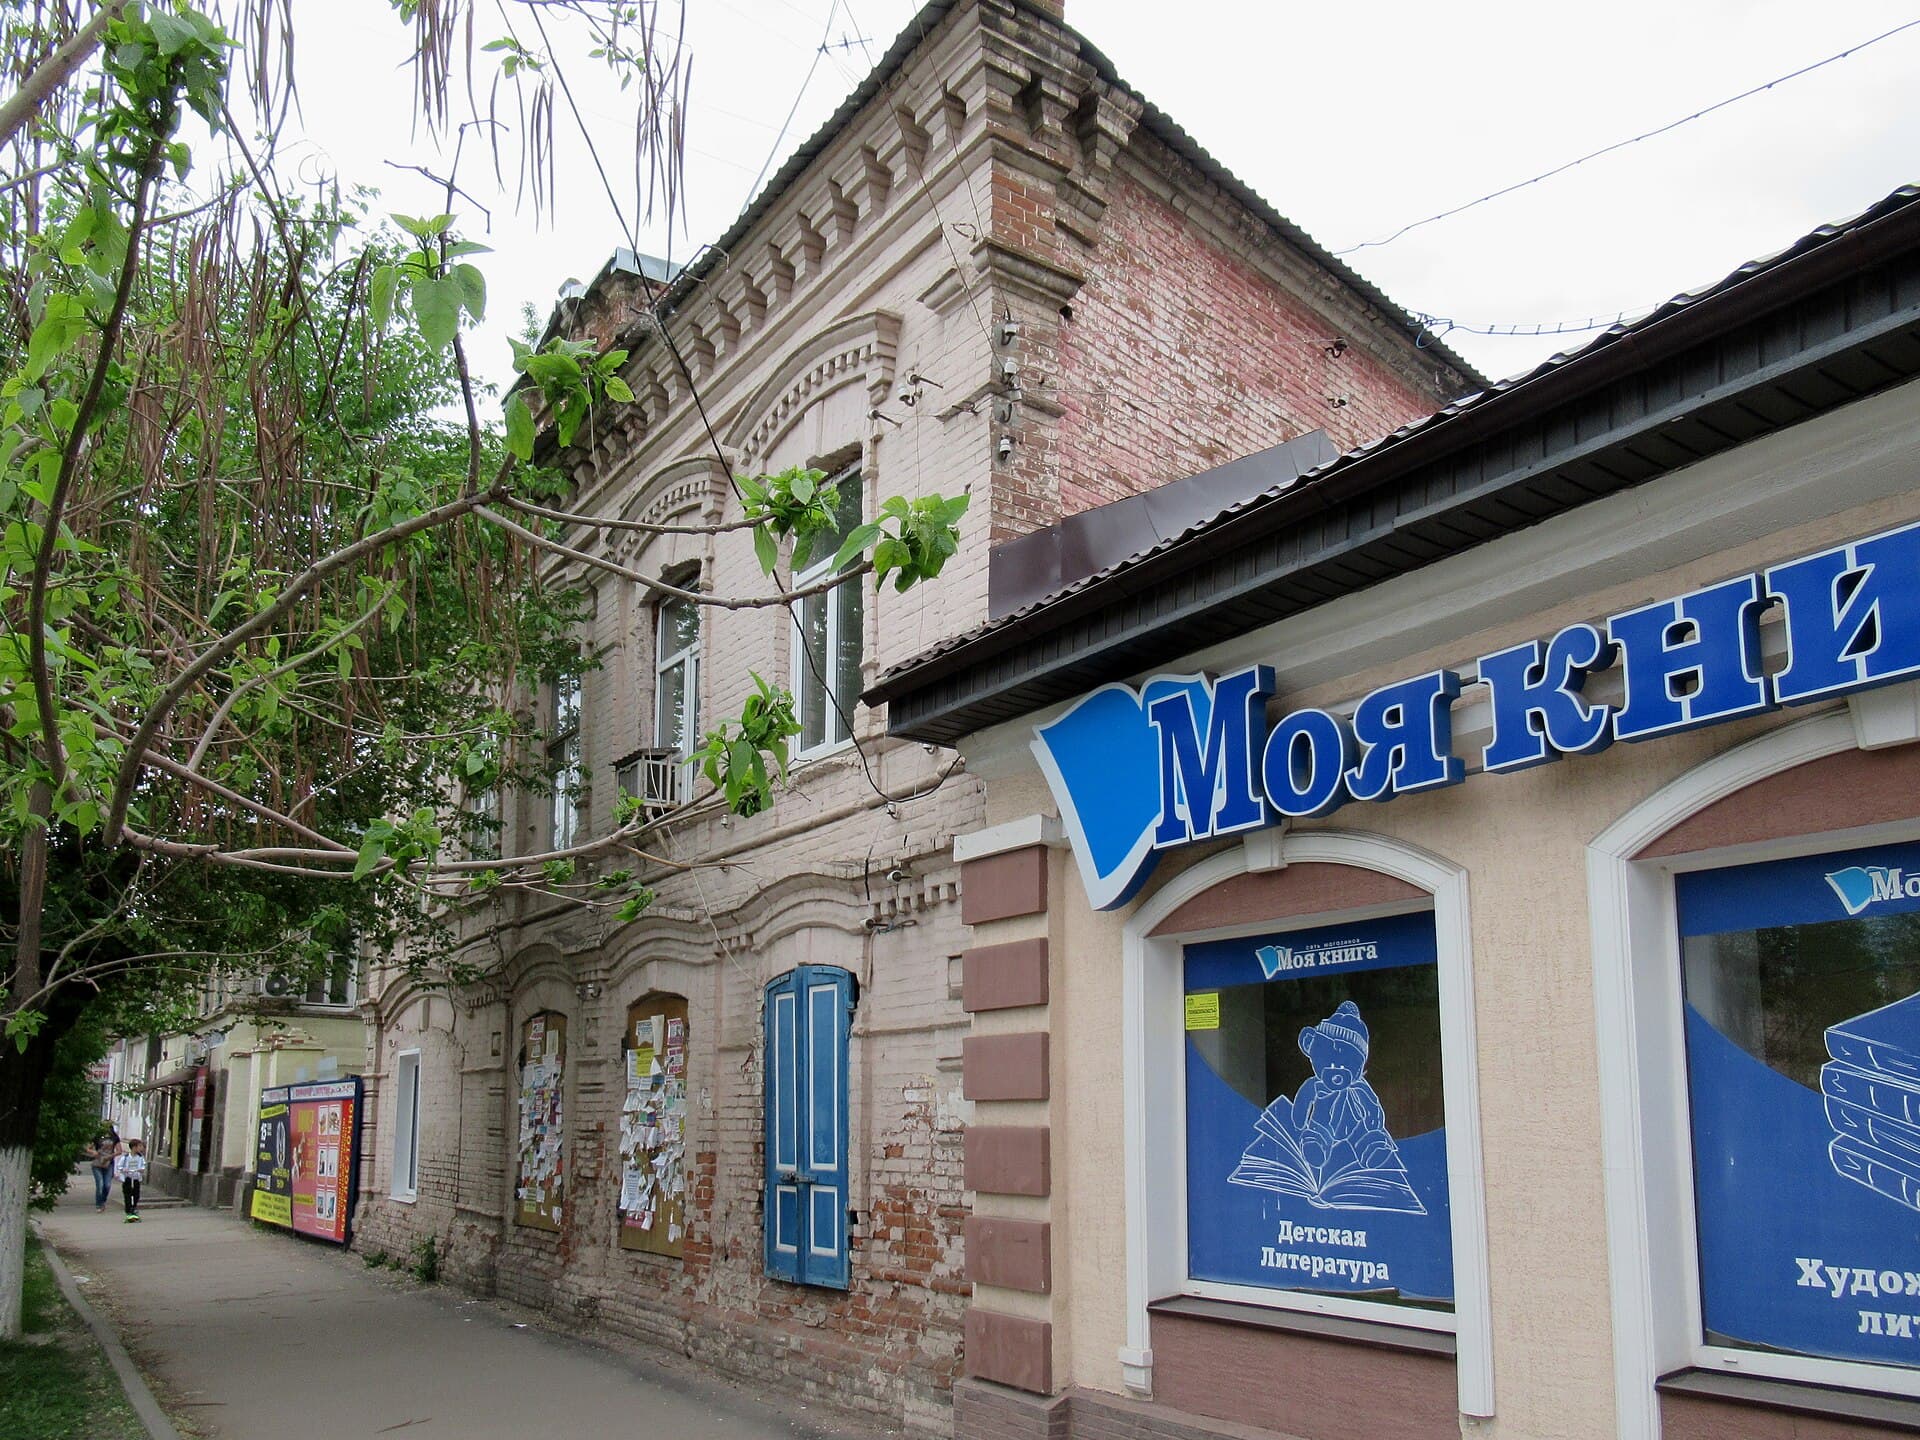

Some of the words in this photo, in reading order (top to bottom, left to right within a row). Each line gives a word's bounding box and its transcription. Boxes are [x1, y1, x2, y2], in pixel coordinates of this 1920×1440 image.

[1148, 663, 1460, 850] Моя
[1276, 948, 1316, 971] Моя
[1318, 943, 1379, 966] книга
[1324, 938, 1361, 948] магазинов
[1278, 1220, 1367, 1248] Детская
[1260, 1247, 1390, 1284] Литература
